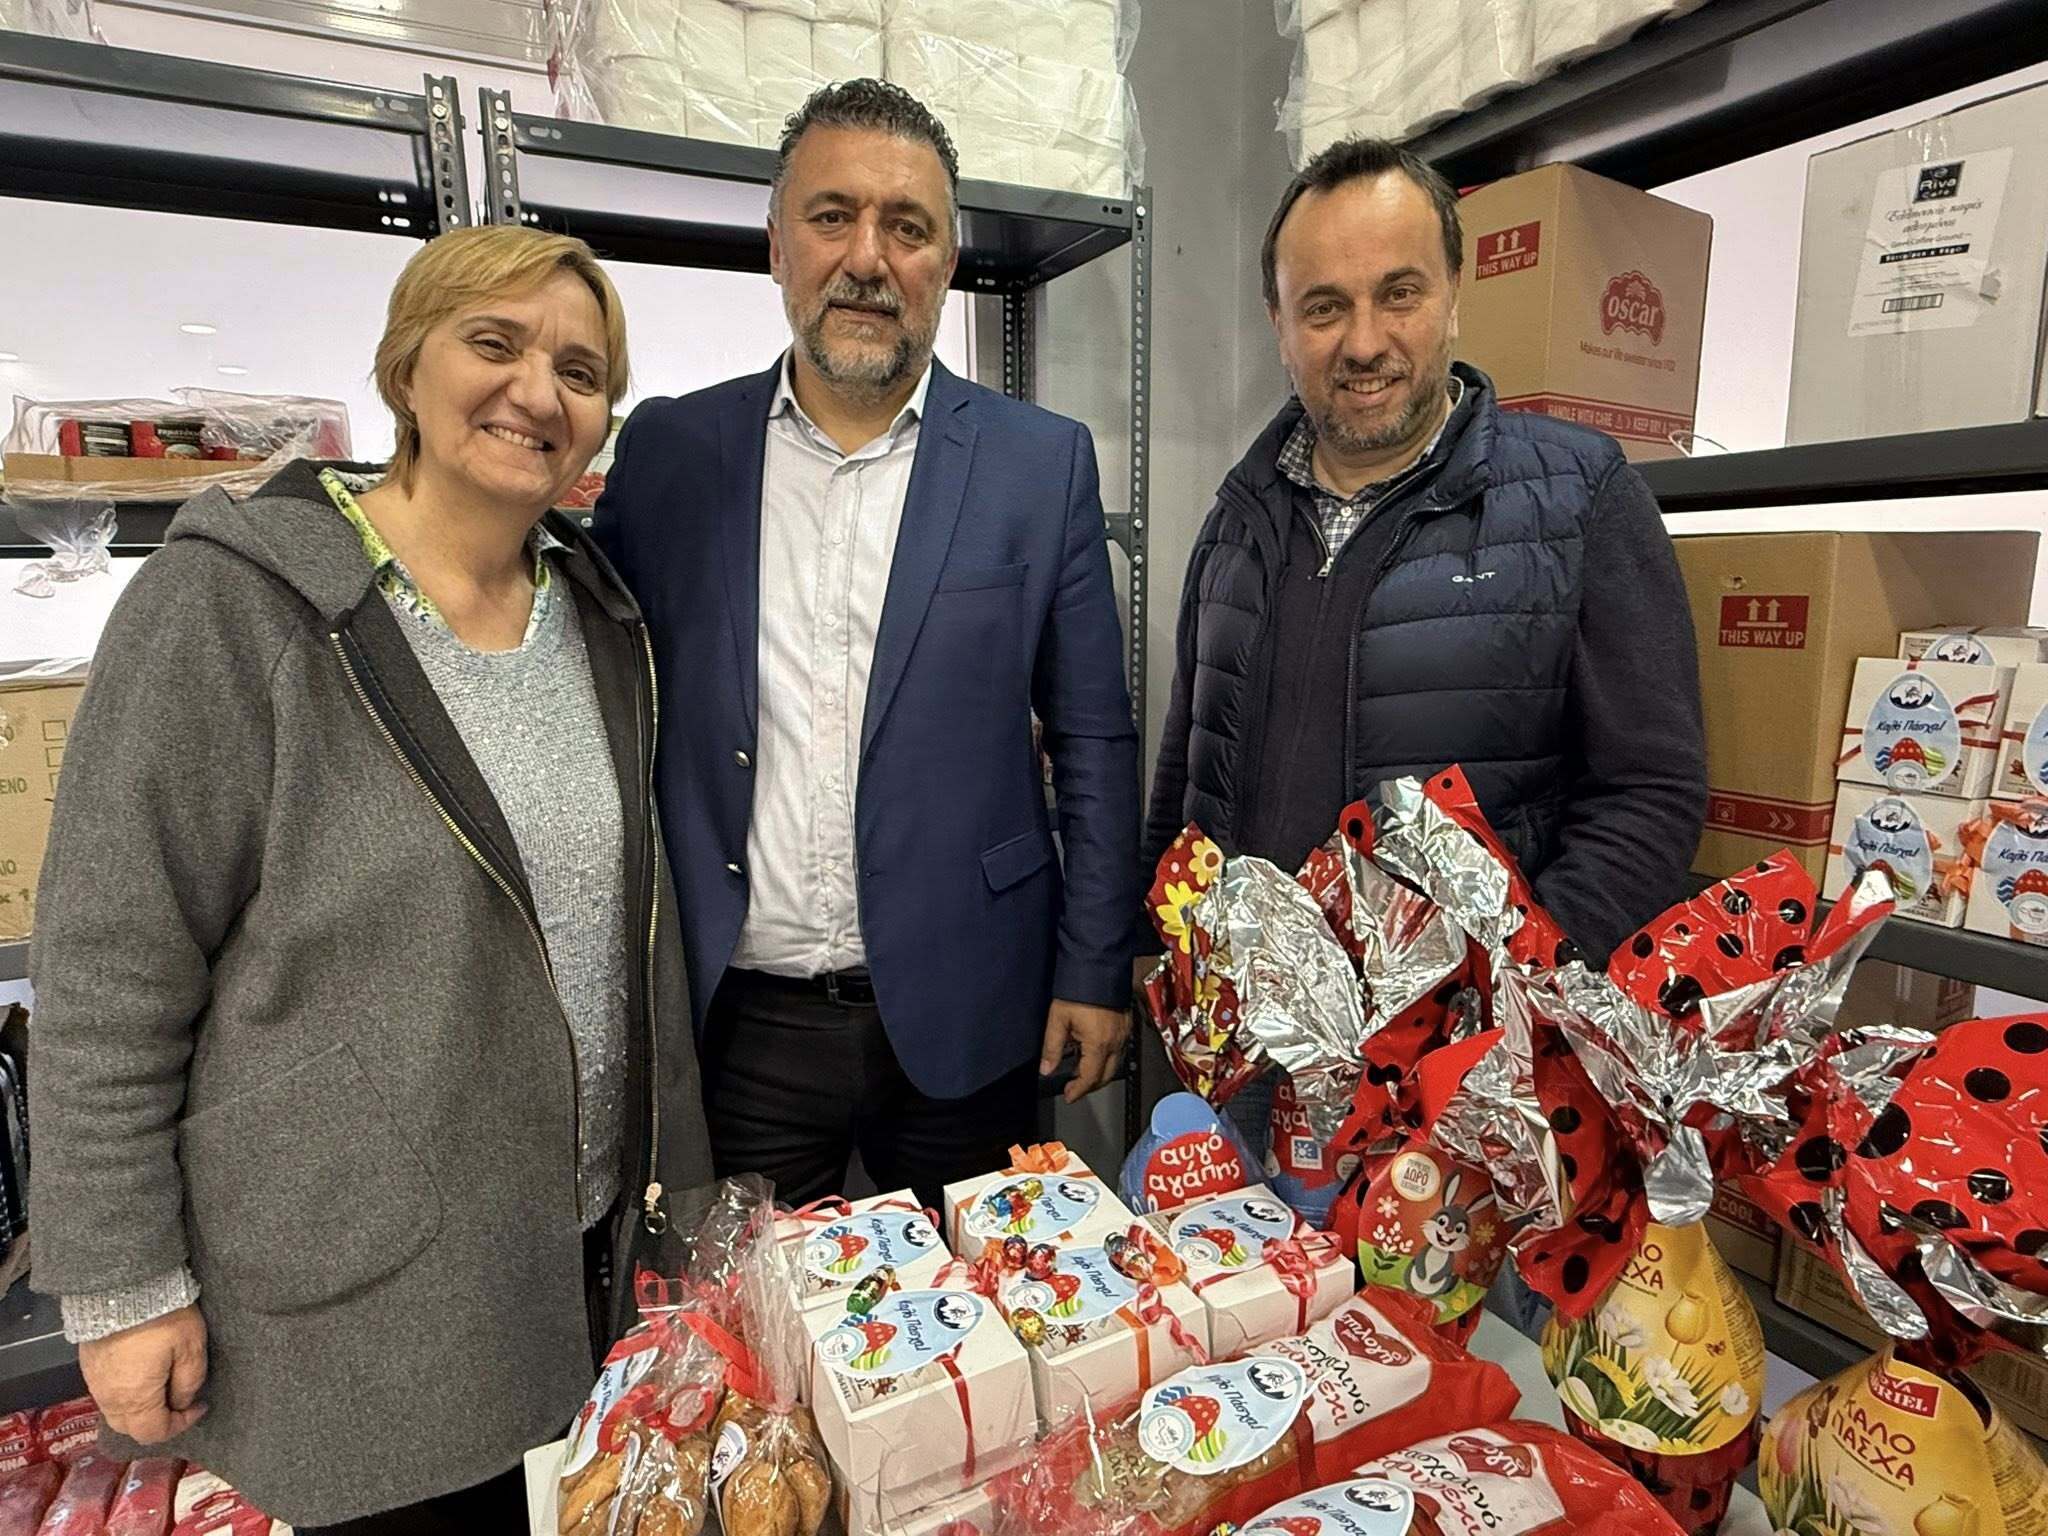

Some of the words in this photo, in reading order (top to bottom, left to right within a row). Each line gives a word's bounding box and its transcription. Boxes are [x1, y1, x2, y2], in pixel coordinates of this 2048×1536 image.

[1919, 178, 1957, 191] Riva
[1477, 260, 1499, 278] THIS
[1500, 256, 1522, 273] WAY
[1523, 251, 1537, 266] UP
[1607, 296, 1659, 327] oscar
[1720, 629, 1750, 644] THIS
[1753, 630, 1782, 645] WAY
[1785, 631, 1804, 646] UP
[1272, 1104, 1309, 1133] αγά
[1160, 1123, 1223, 1165] αυγό
[1148, 1158, 1240, 1198] αγάπης
[1403, 1167, 1429, 1186] ΔΩΡΟ
[1720, 1197, 1752, 1219] COOL
[1843, 1399, 1916, 1455] ΚΑΛΟ
[49, 1429, 99, 1455] ΦΑΡΙΝ
[1831, 1409, 1915, 1486] ΠΑΣΧΑ
